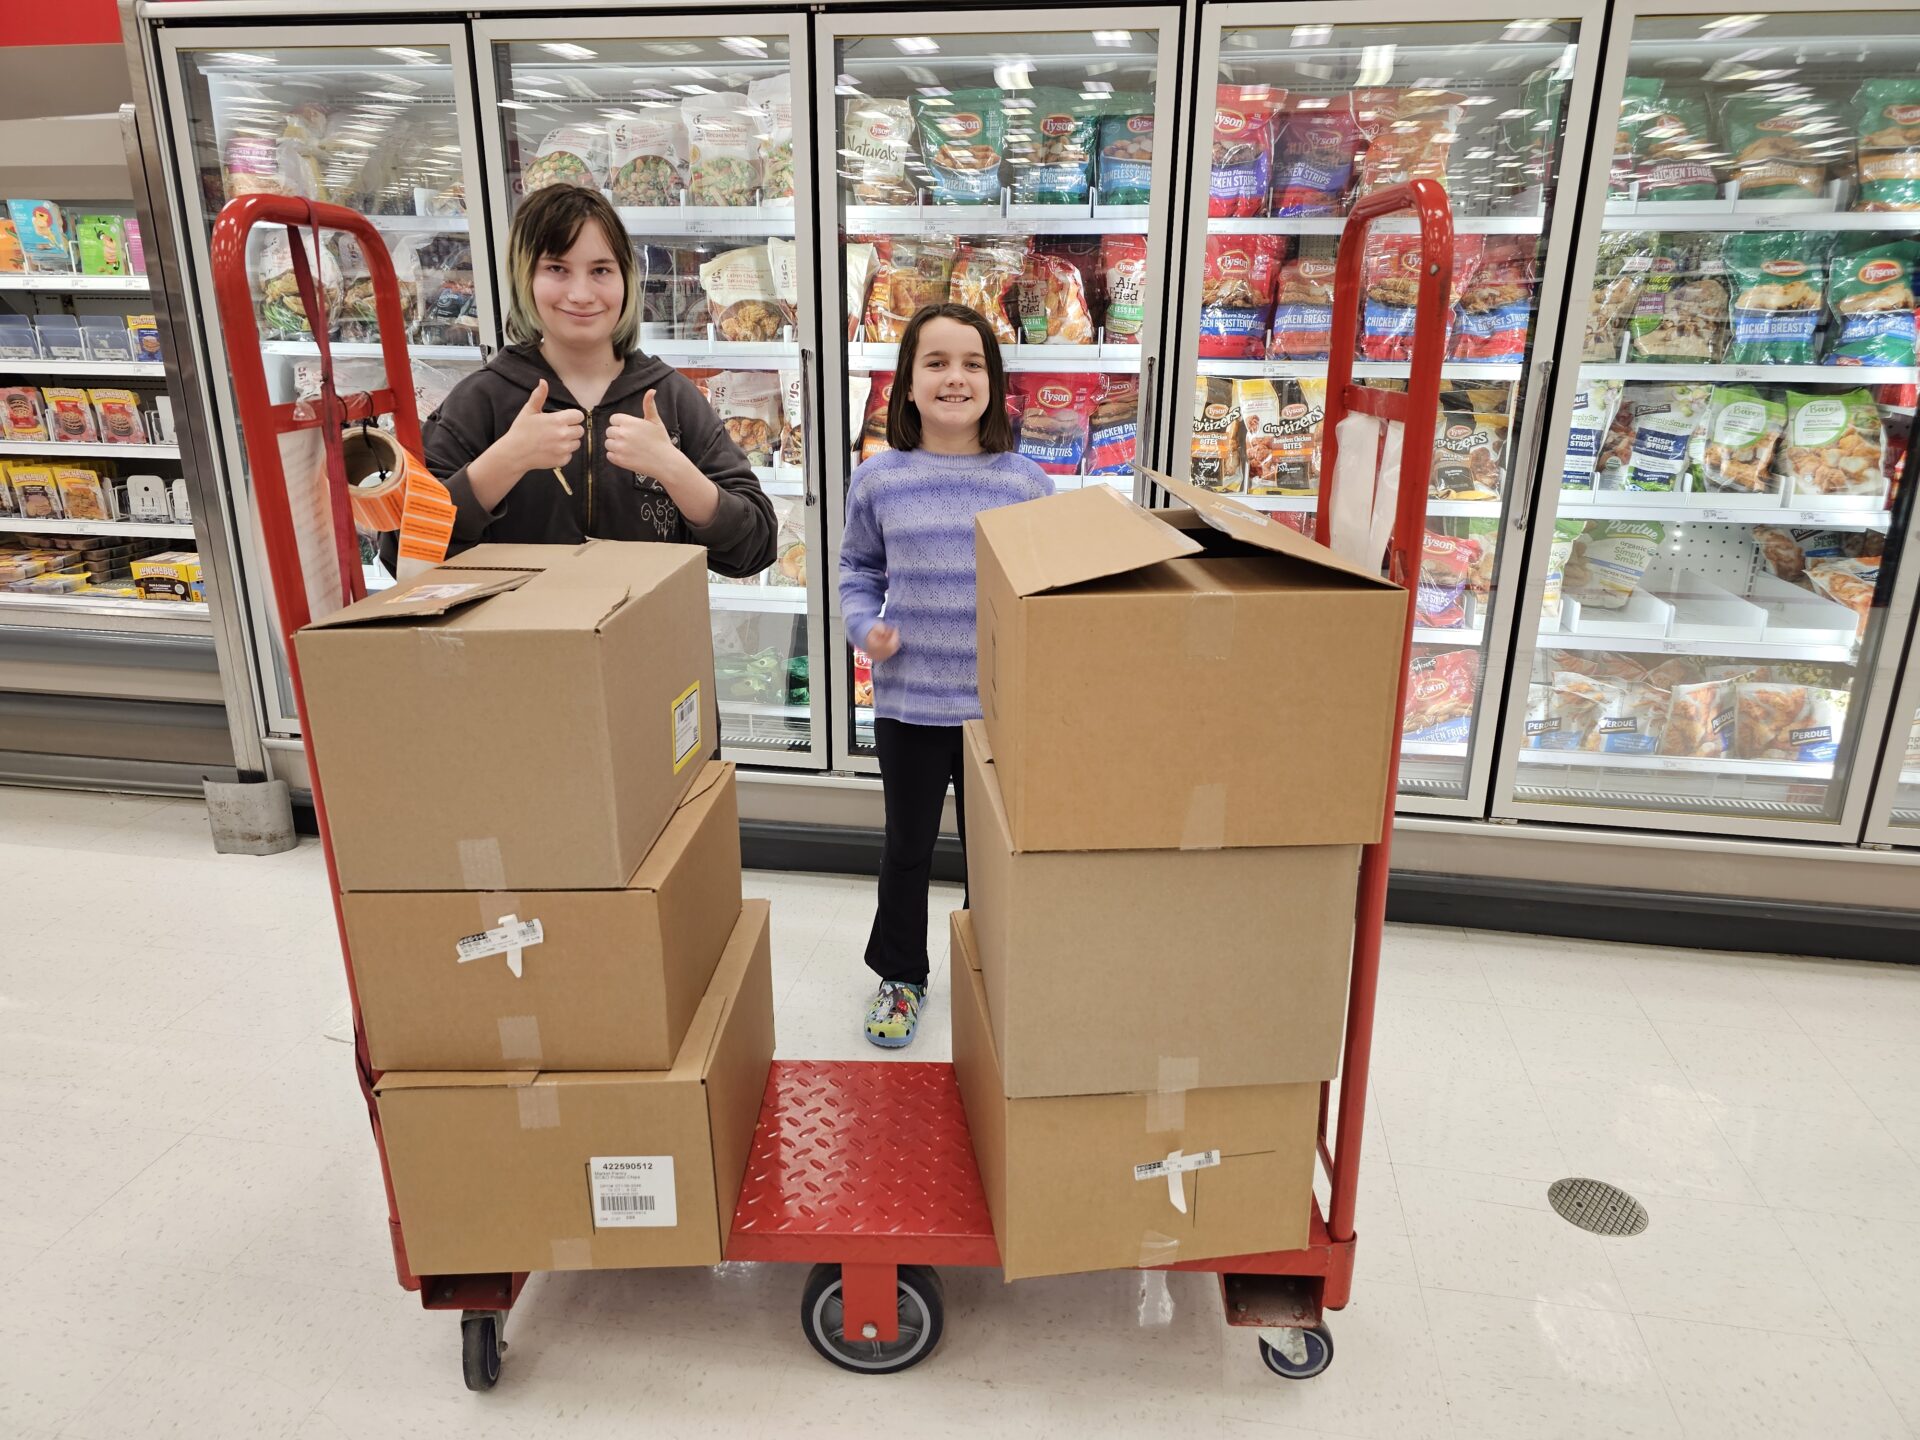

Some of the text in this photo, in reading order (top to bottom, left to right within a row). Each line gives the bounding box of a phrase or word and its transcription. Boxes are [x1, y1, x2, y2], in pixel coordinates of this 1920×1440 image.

[1310, 132, 1341, 146] Tyson
[847, 136, 898, 162] Naturals
[1303, 169, 1332, 185] STRIPS
[1649, 167, 1712, 181] CHICKEN TENDE
[1211, 175, 1257, 188] ICKEN STRIPS
[1224, 254, 1249, 270] Tyson
[1116, 276, 1137, 290] Air
[1109, 287, 1138, 301] Fried
[1020, 303, 1040, 313] ried
[1199, 319, 1213, 328] CKEN
[1275, 314, 1331, 327] CHICKEN BREAST
[1366, 316, 1398, 327] CHICKEN
[1479, 317, 1505, 331] BREAST
[1771, 322, 1802, 333] BREAST
[1042, 389, 1069, 402] Tyson
[1285, 407, 1305, 416] Tyson
[1093, 425, 1124, 441] CHICKEN
[1283, 442, 1302, 450] BITES
[1646, 442, 1674, 452] STRIPS
[1647, 436, 1676, 446] CRISPY
[1047, 447, 1073, 457] PATTIES
[1605, 520, 1658, 540] Perdue
[1423, 536, 1454, 550] Tyson
[1620, 541, 1647, 552] organic
[1614, 547, 1645, 560] Simply
[139, 566, 179, 578] LUNCHABLES
[1417, 683, 1445, 697] Tyson
[1527, 720, 1559, 731] PERDUE
[1417, 726, 1469, 742] HICKEN FRIES
[1792, 728, 1830, 740] PERDUE
